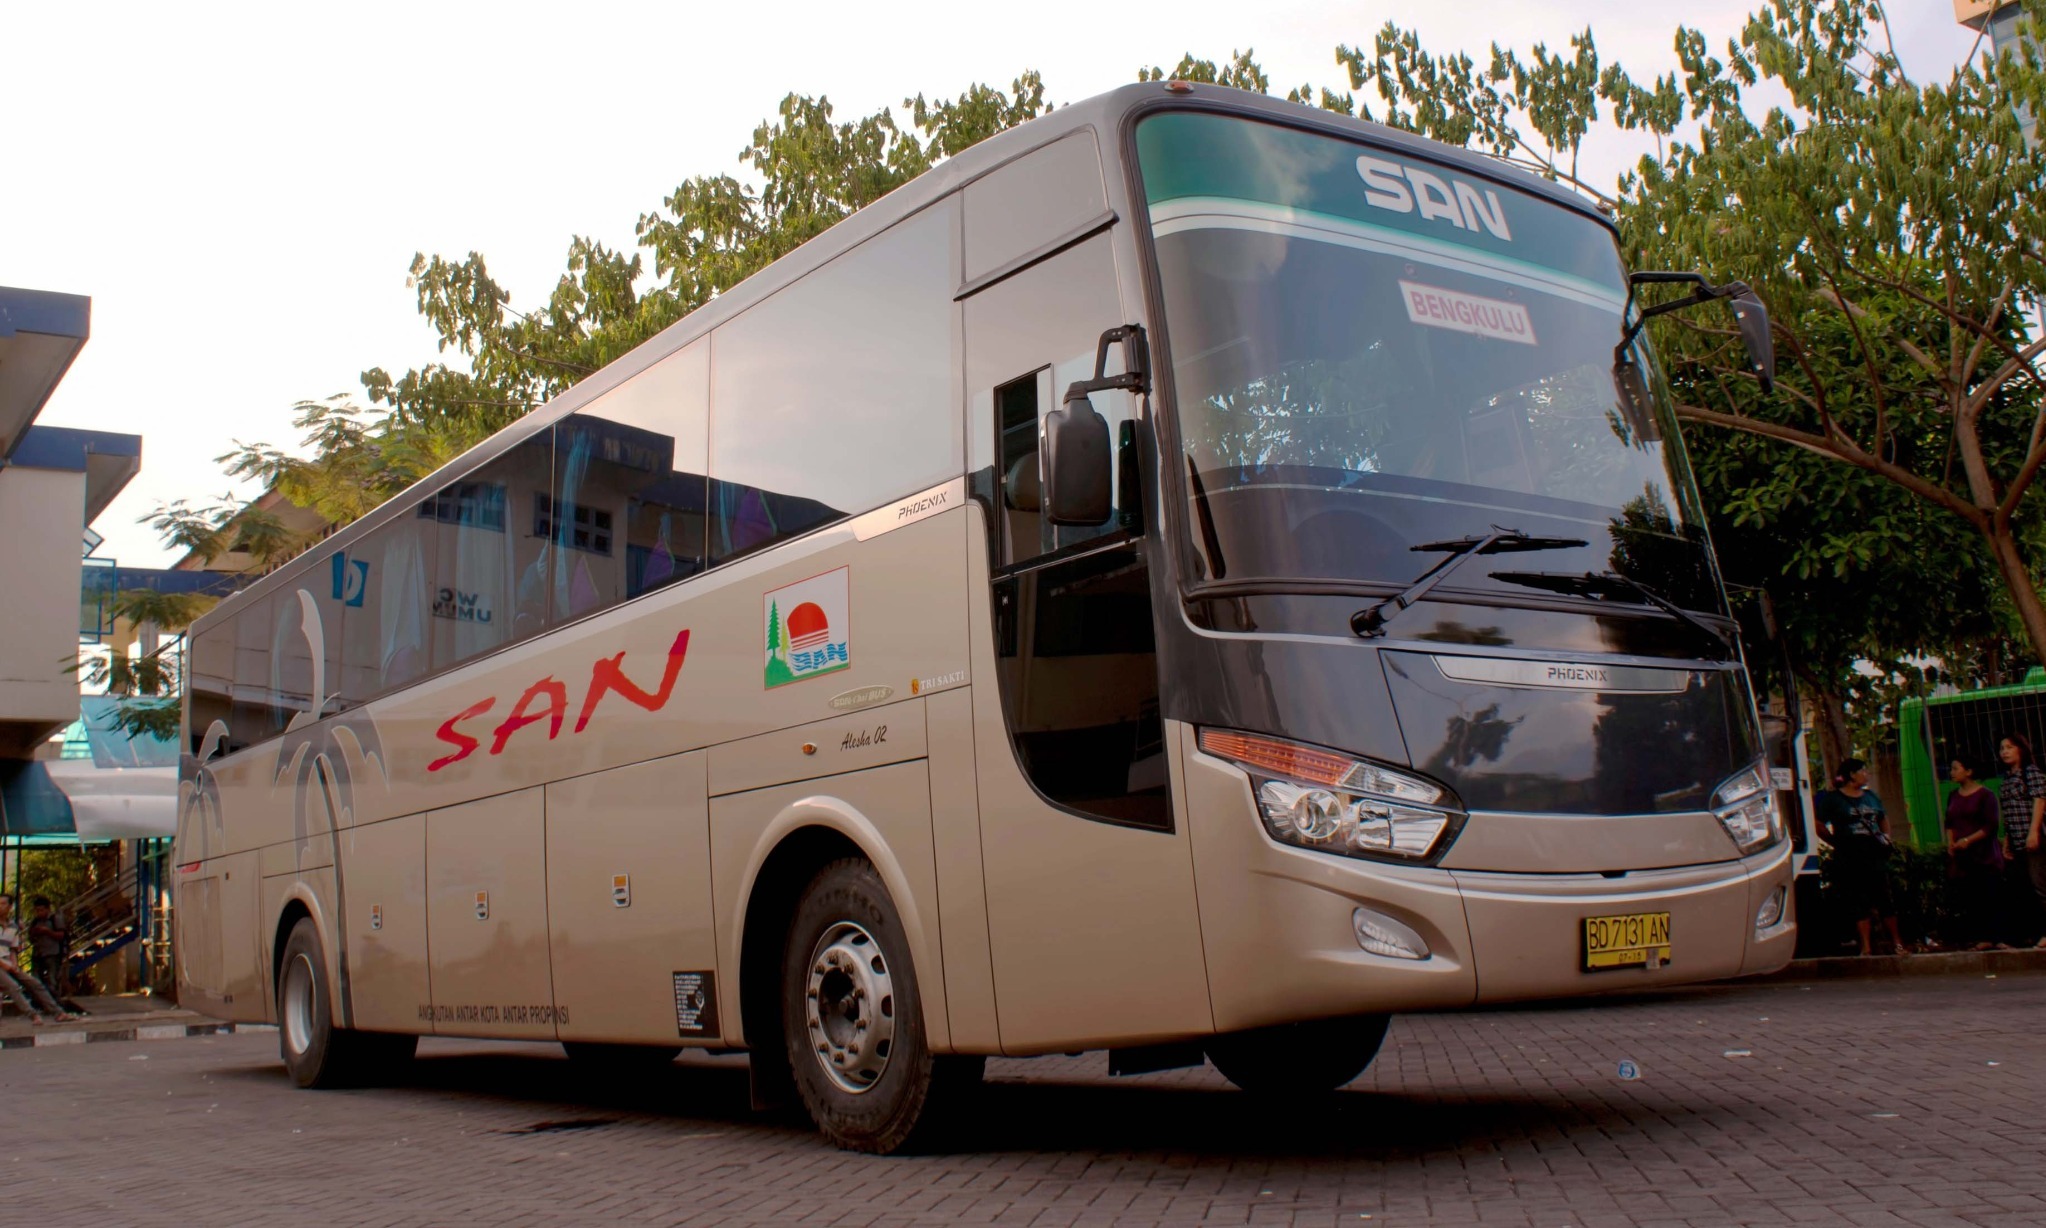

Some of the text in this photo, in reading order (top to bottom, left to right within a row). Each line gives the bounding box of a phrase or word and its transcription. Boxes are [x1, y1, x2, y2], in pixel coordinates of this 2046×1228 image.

[1356, 155, 1513, 241] SAN
[1410, 291, 1527, 336] BENGKULU
[898, 491, 947, 520] PHOENIX
[920, 679, 936, 691] TRI
[938, 671, 965, 686] SAKTI
[1547, 667, 1608, 682] PHOENIX
[427, 629, 690, 772] SAN
[874, 725, 887, 744] 02
[1589, 915, 1670, 949] BD 7131 AN
[456, 1005, 479, 1023] ANTAR
[480, 1005, 499, 1023] KOTA
[503, 1005, 528, 1024] ANTAR
